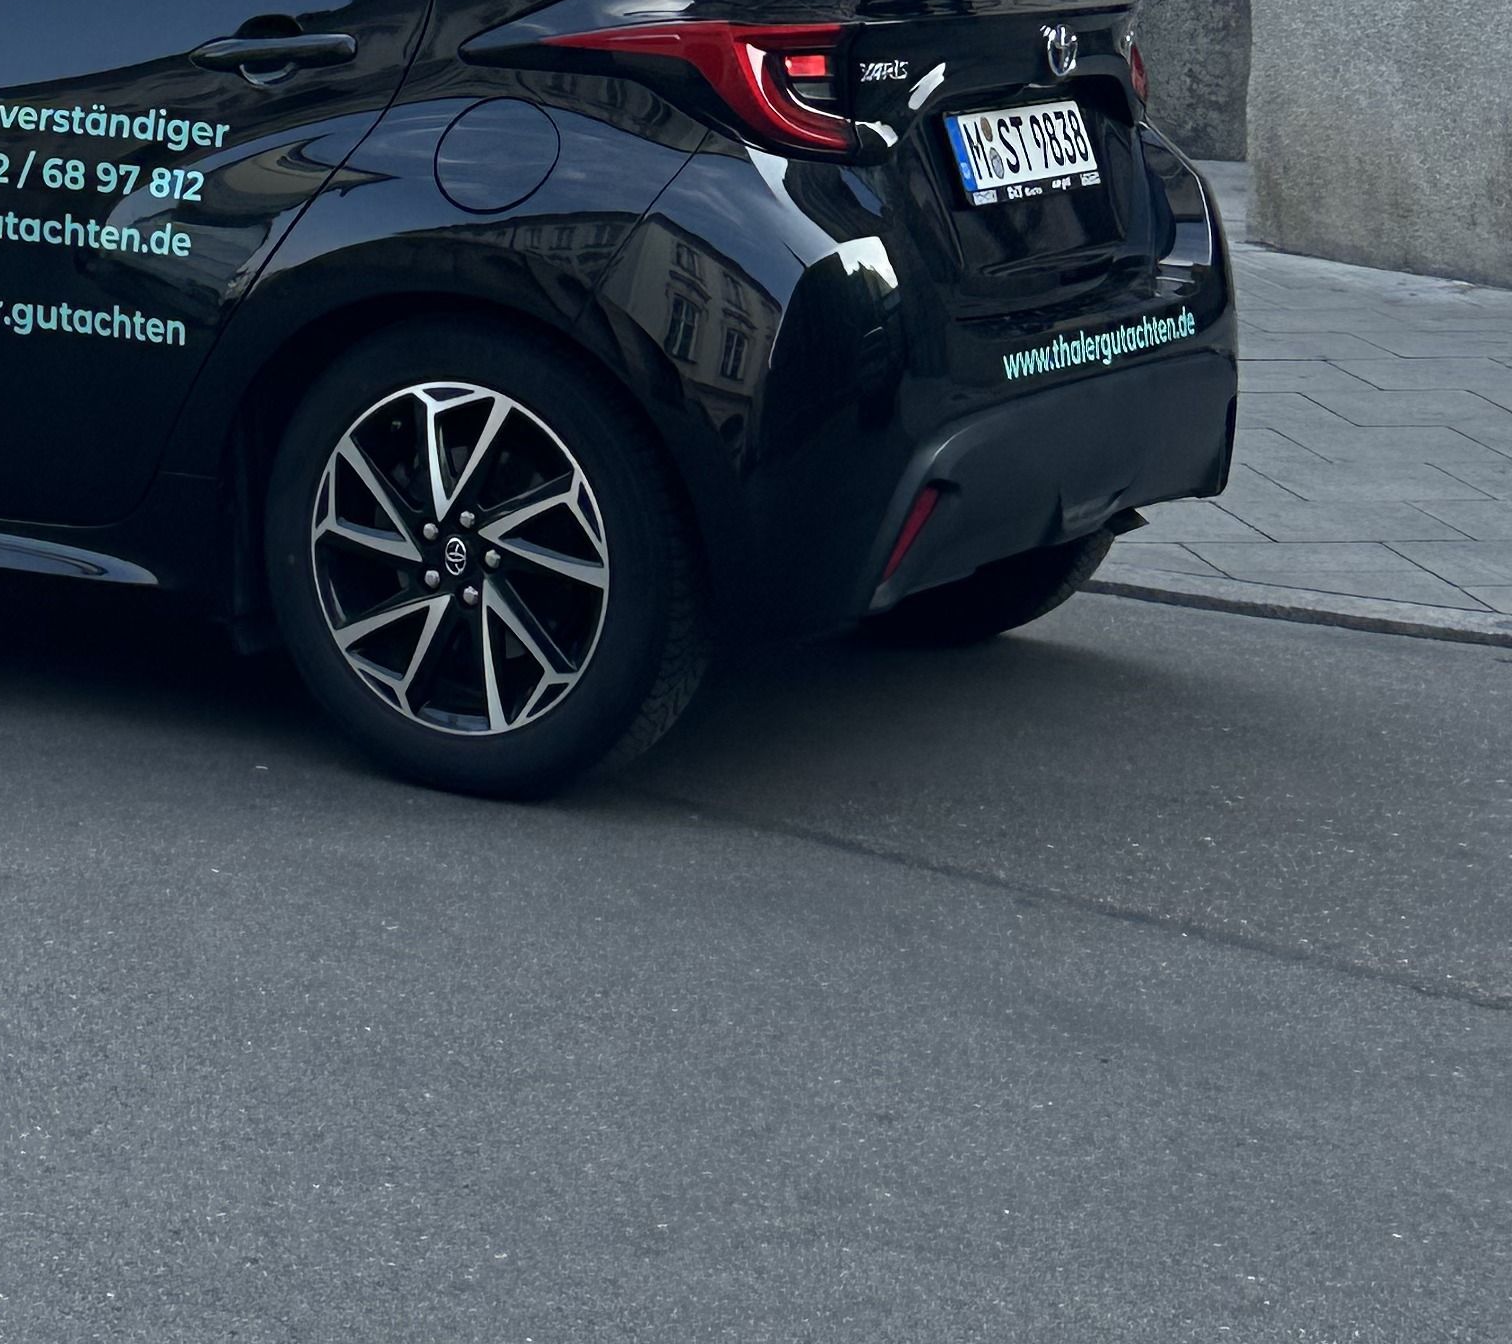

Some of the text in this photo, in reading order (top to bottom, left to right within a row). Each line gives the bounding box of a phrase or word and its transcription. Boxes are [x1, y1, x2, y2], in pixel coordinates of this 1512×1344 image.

[996, 115, 1033, 175] ST
[1029, 109, 1089, 170] 9838
[42, 157, 86, 191] 68
[96, 162, 141, 195] 97
[149, 167, 205, 202] 812
[1003, 305, 1196, 381] www.thalergutachten.de
